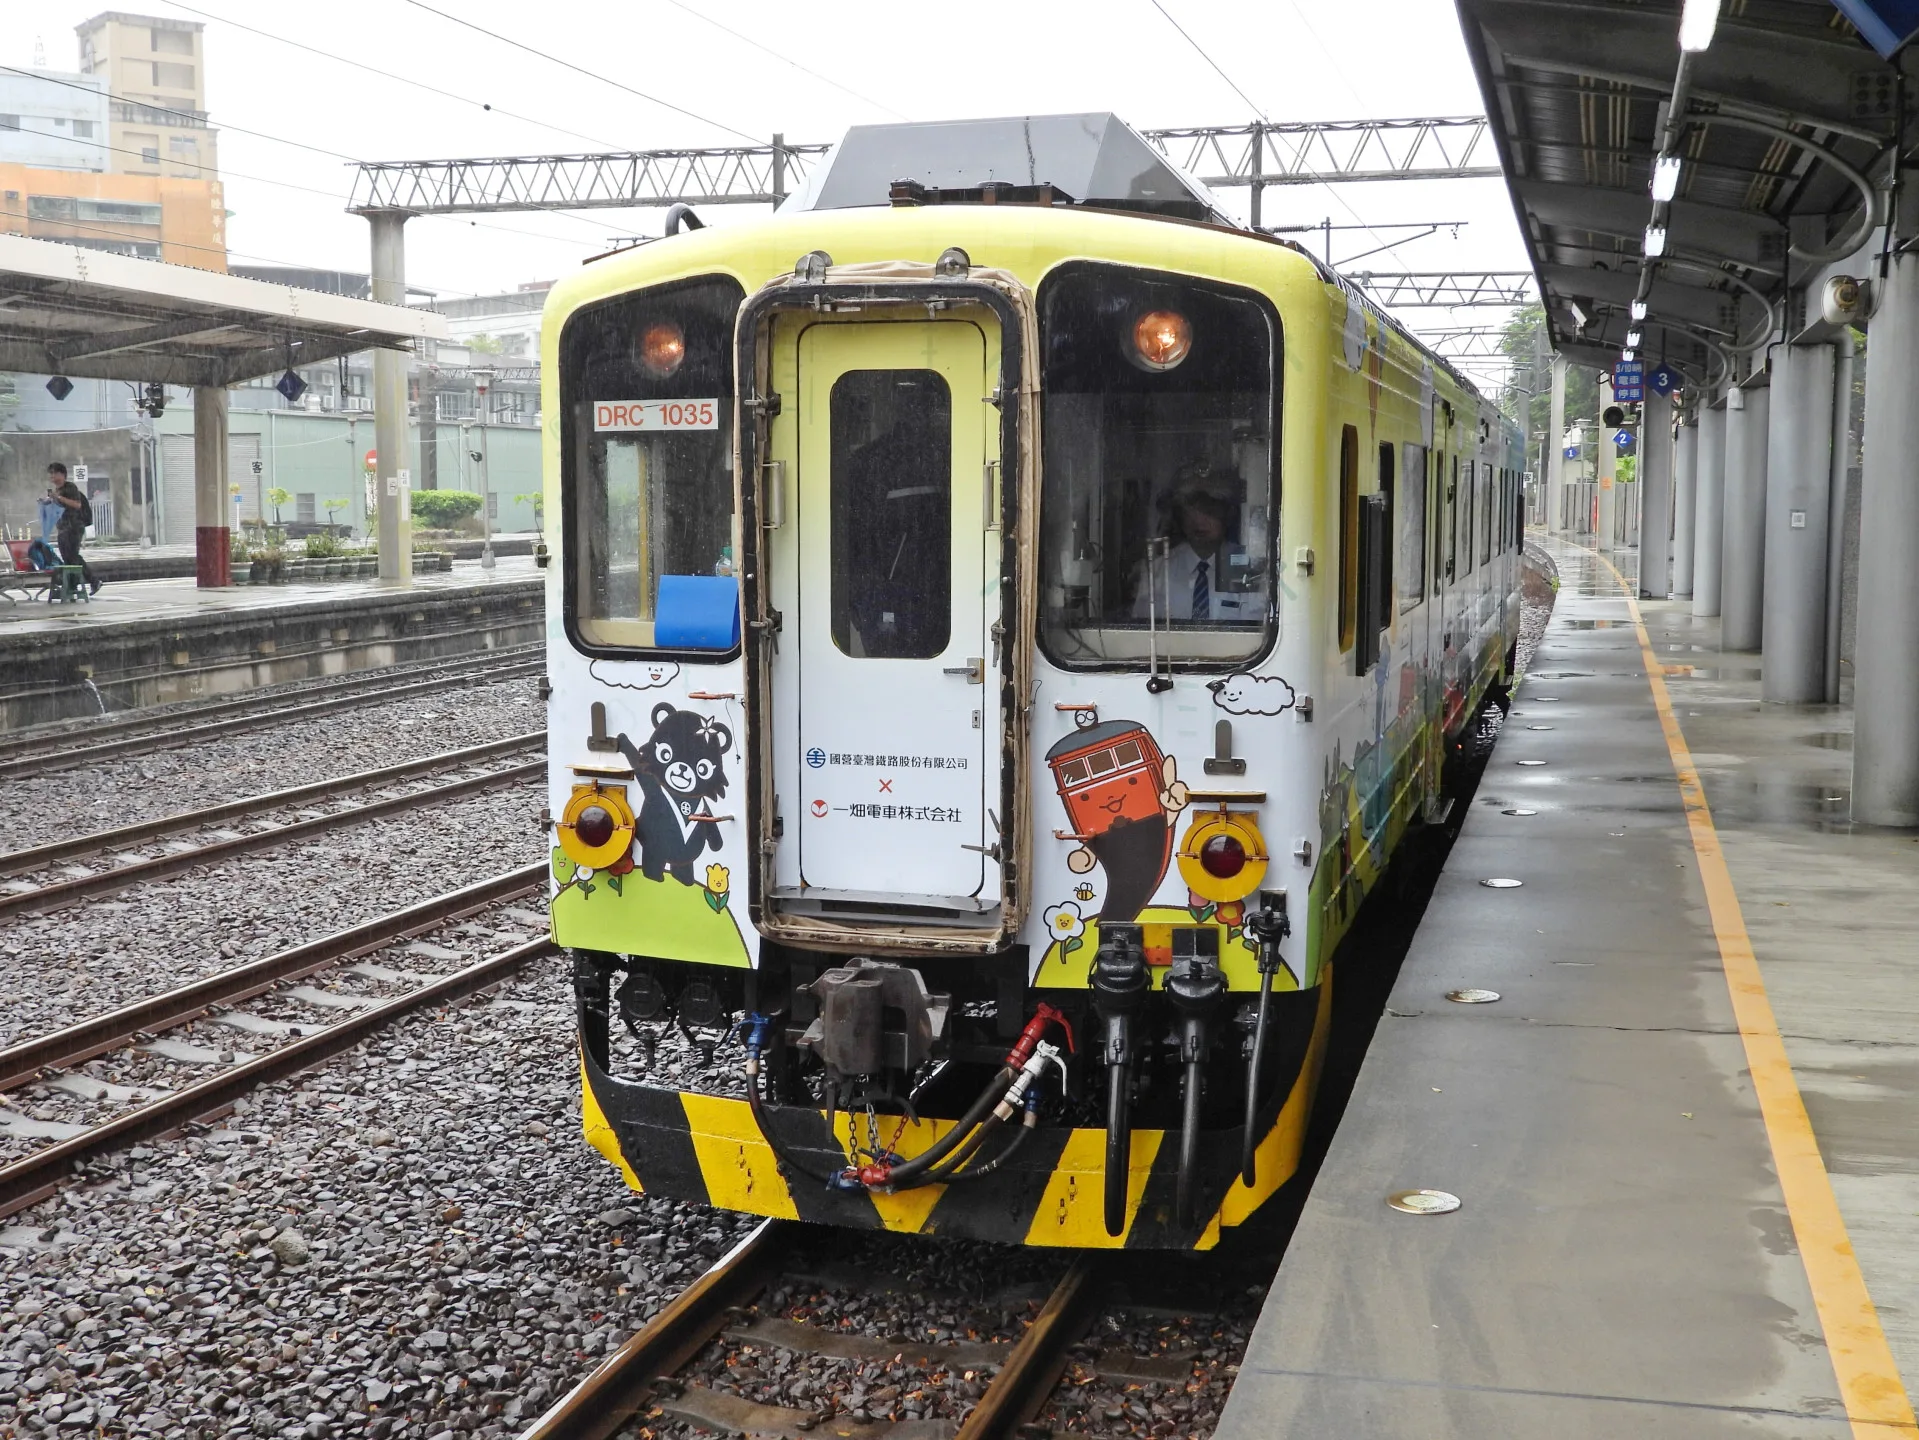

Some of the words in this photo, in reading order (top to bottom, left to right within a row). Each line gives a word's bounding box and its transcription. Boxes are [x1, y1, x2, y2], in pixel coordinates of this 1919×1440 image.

[1618, 375, 1640, 386] 電車
[1658, 372, 1669, 387] 3
[1618, 388, 1640, 399] 停車
[597, 404, 645, 427] DRC
[659, 403, 713, 426] 1035
[1619, 433, 1628, 444] 2
[1568, 449, 1575, 457] 1
[75, 467, 86, 480] 客
[251, 461, 263, 474] 客
[829, 753, 968, 770] 國營臺灣鐵路股份有限公司
[832, 803, 962, 823] 一畑電車株式会社
